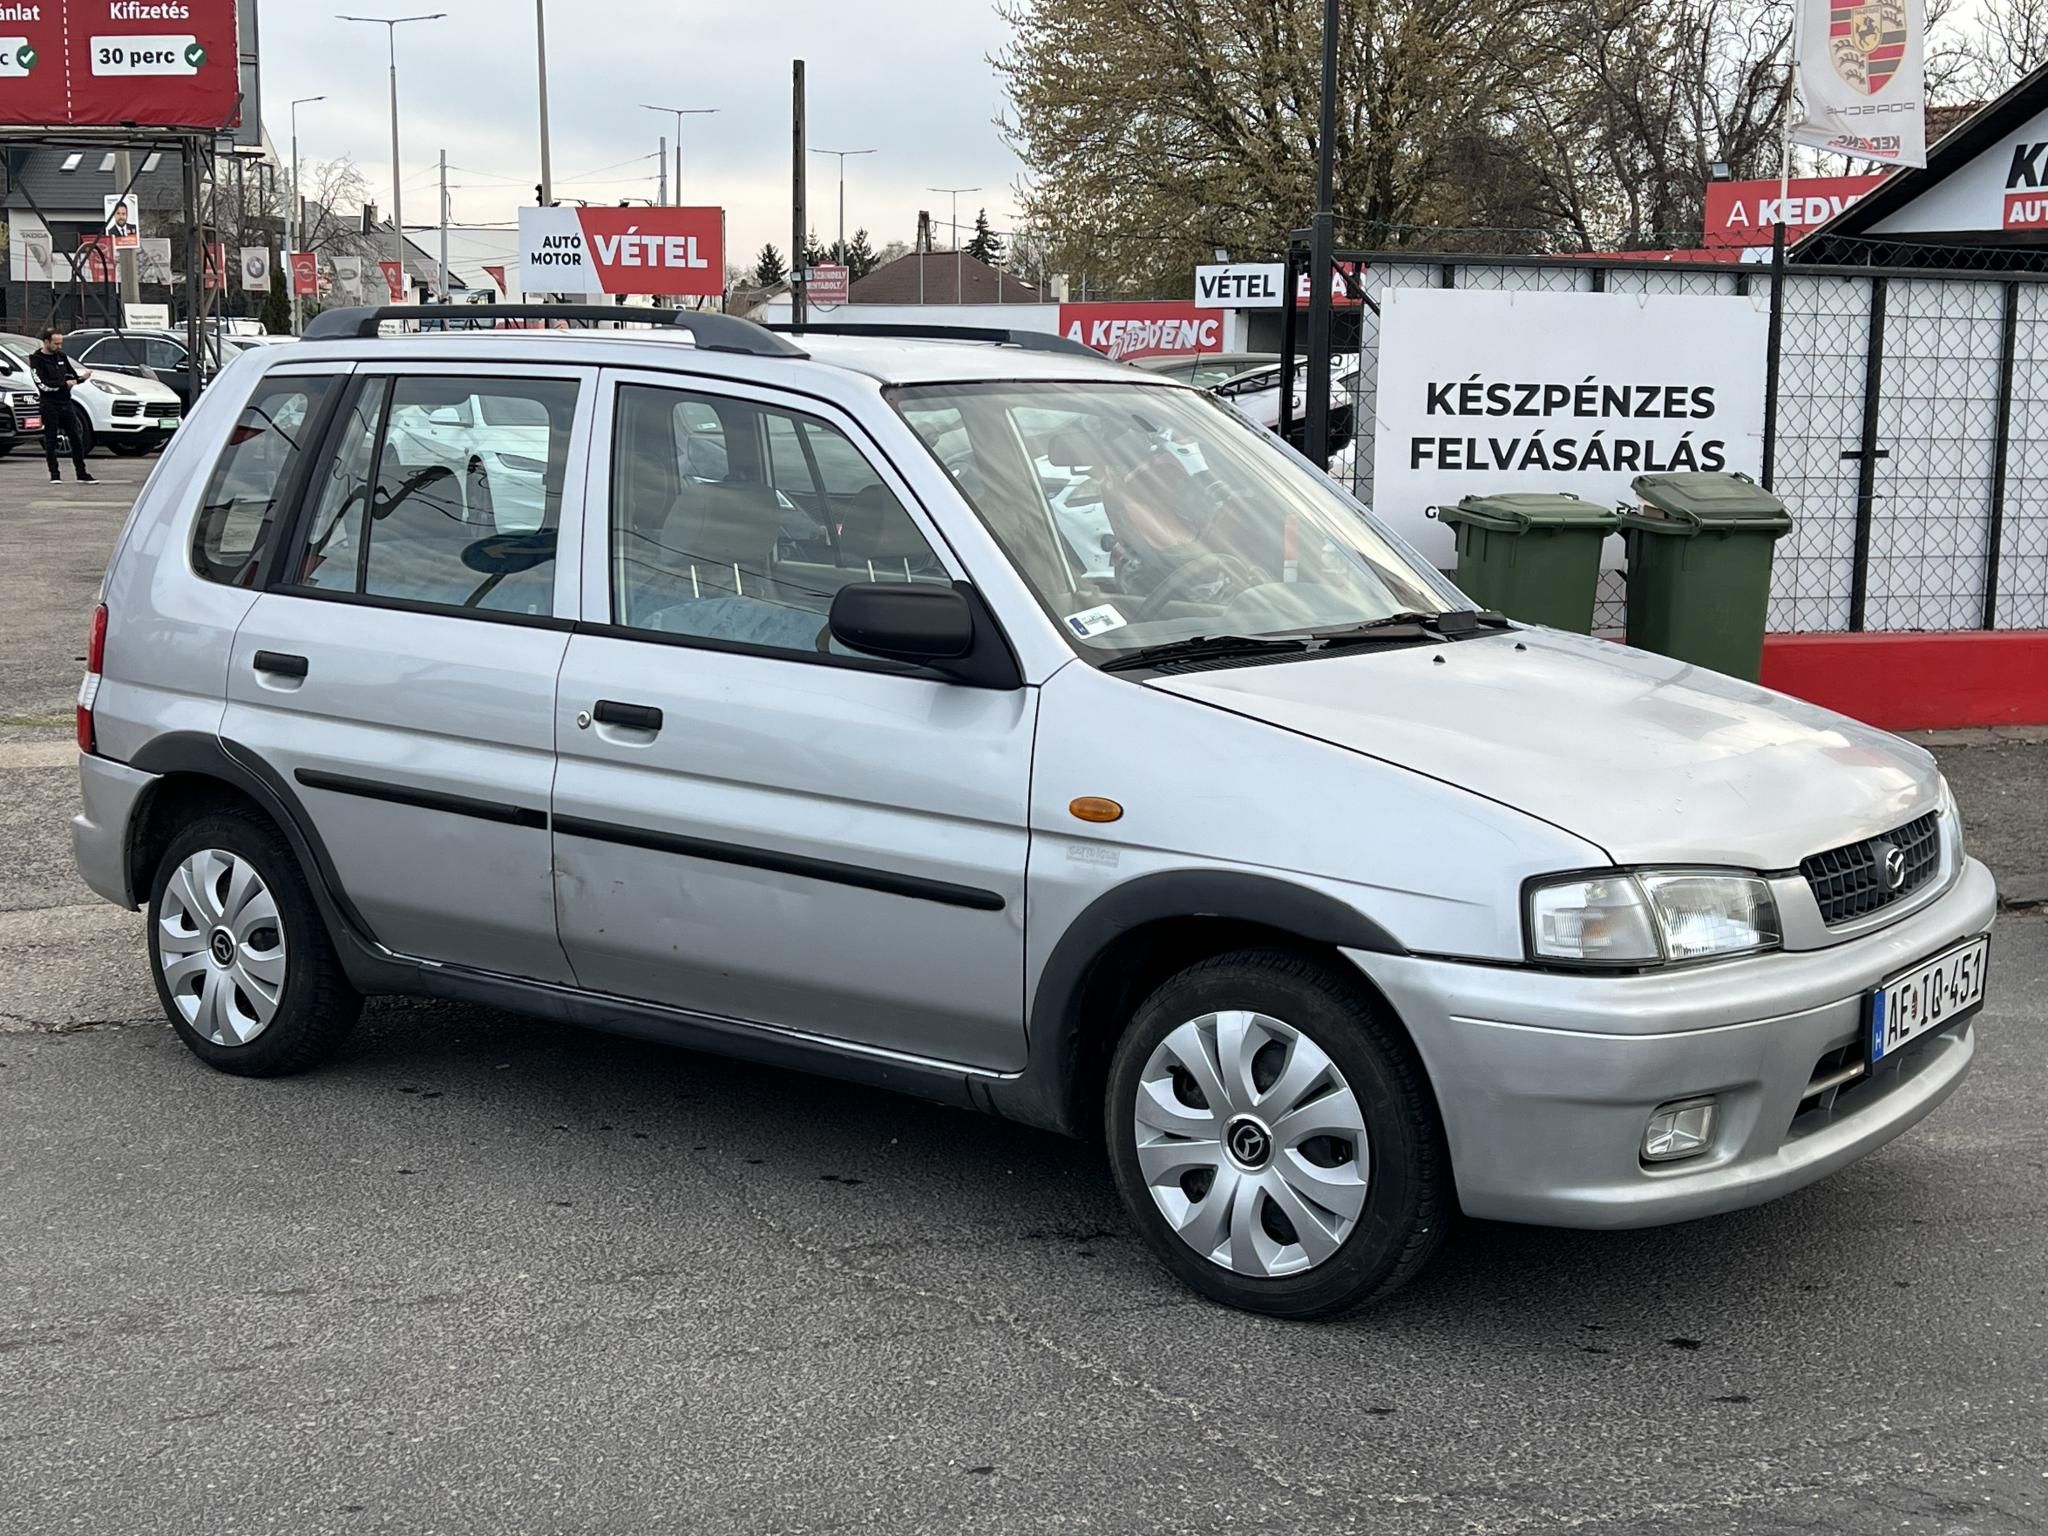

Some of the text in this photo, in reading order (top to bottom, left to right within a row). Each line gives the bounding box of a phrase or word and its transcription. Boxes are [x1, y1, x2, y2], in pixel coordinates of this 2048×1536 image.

[110, 1, 190, 19] Kifizetés
[99, 48, 175, 67] 30 perc
[2005, 142, 2048, 189] K
[1726, 200, 1749, 227] A
[543, 233, 581, 249] AUTÓ
[593, 226, 708, 268] VÉTEL
[531, 253, 581, 265] MOTOR
[1200, 269, 1276, 298] VÉTEL
[1067, 320, 1084, 344] A
[1426, 374, 1715, 419] KÉSZPÉNZES
[1411, 429, 1725, 472] FELVÁSÁRLÁS
[1887, 983, 1911, 1046] AE
